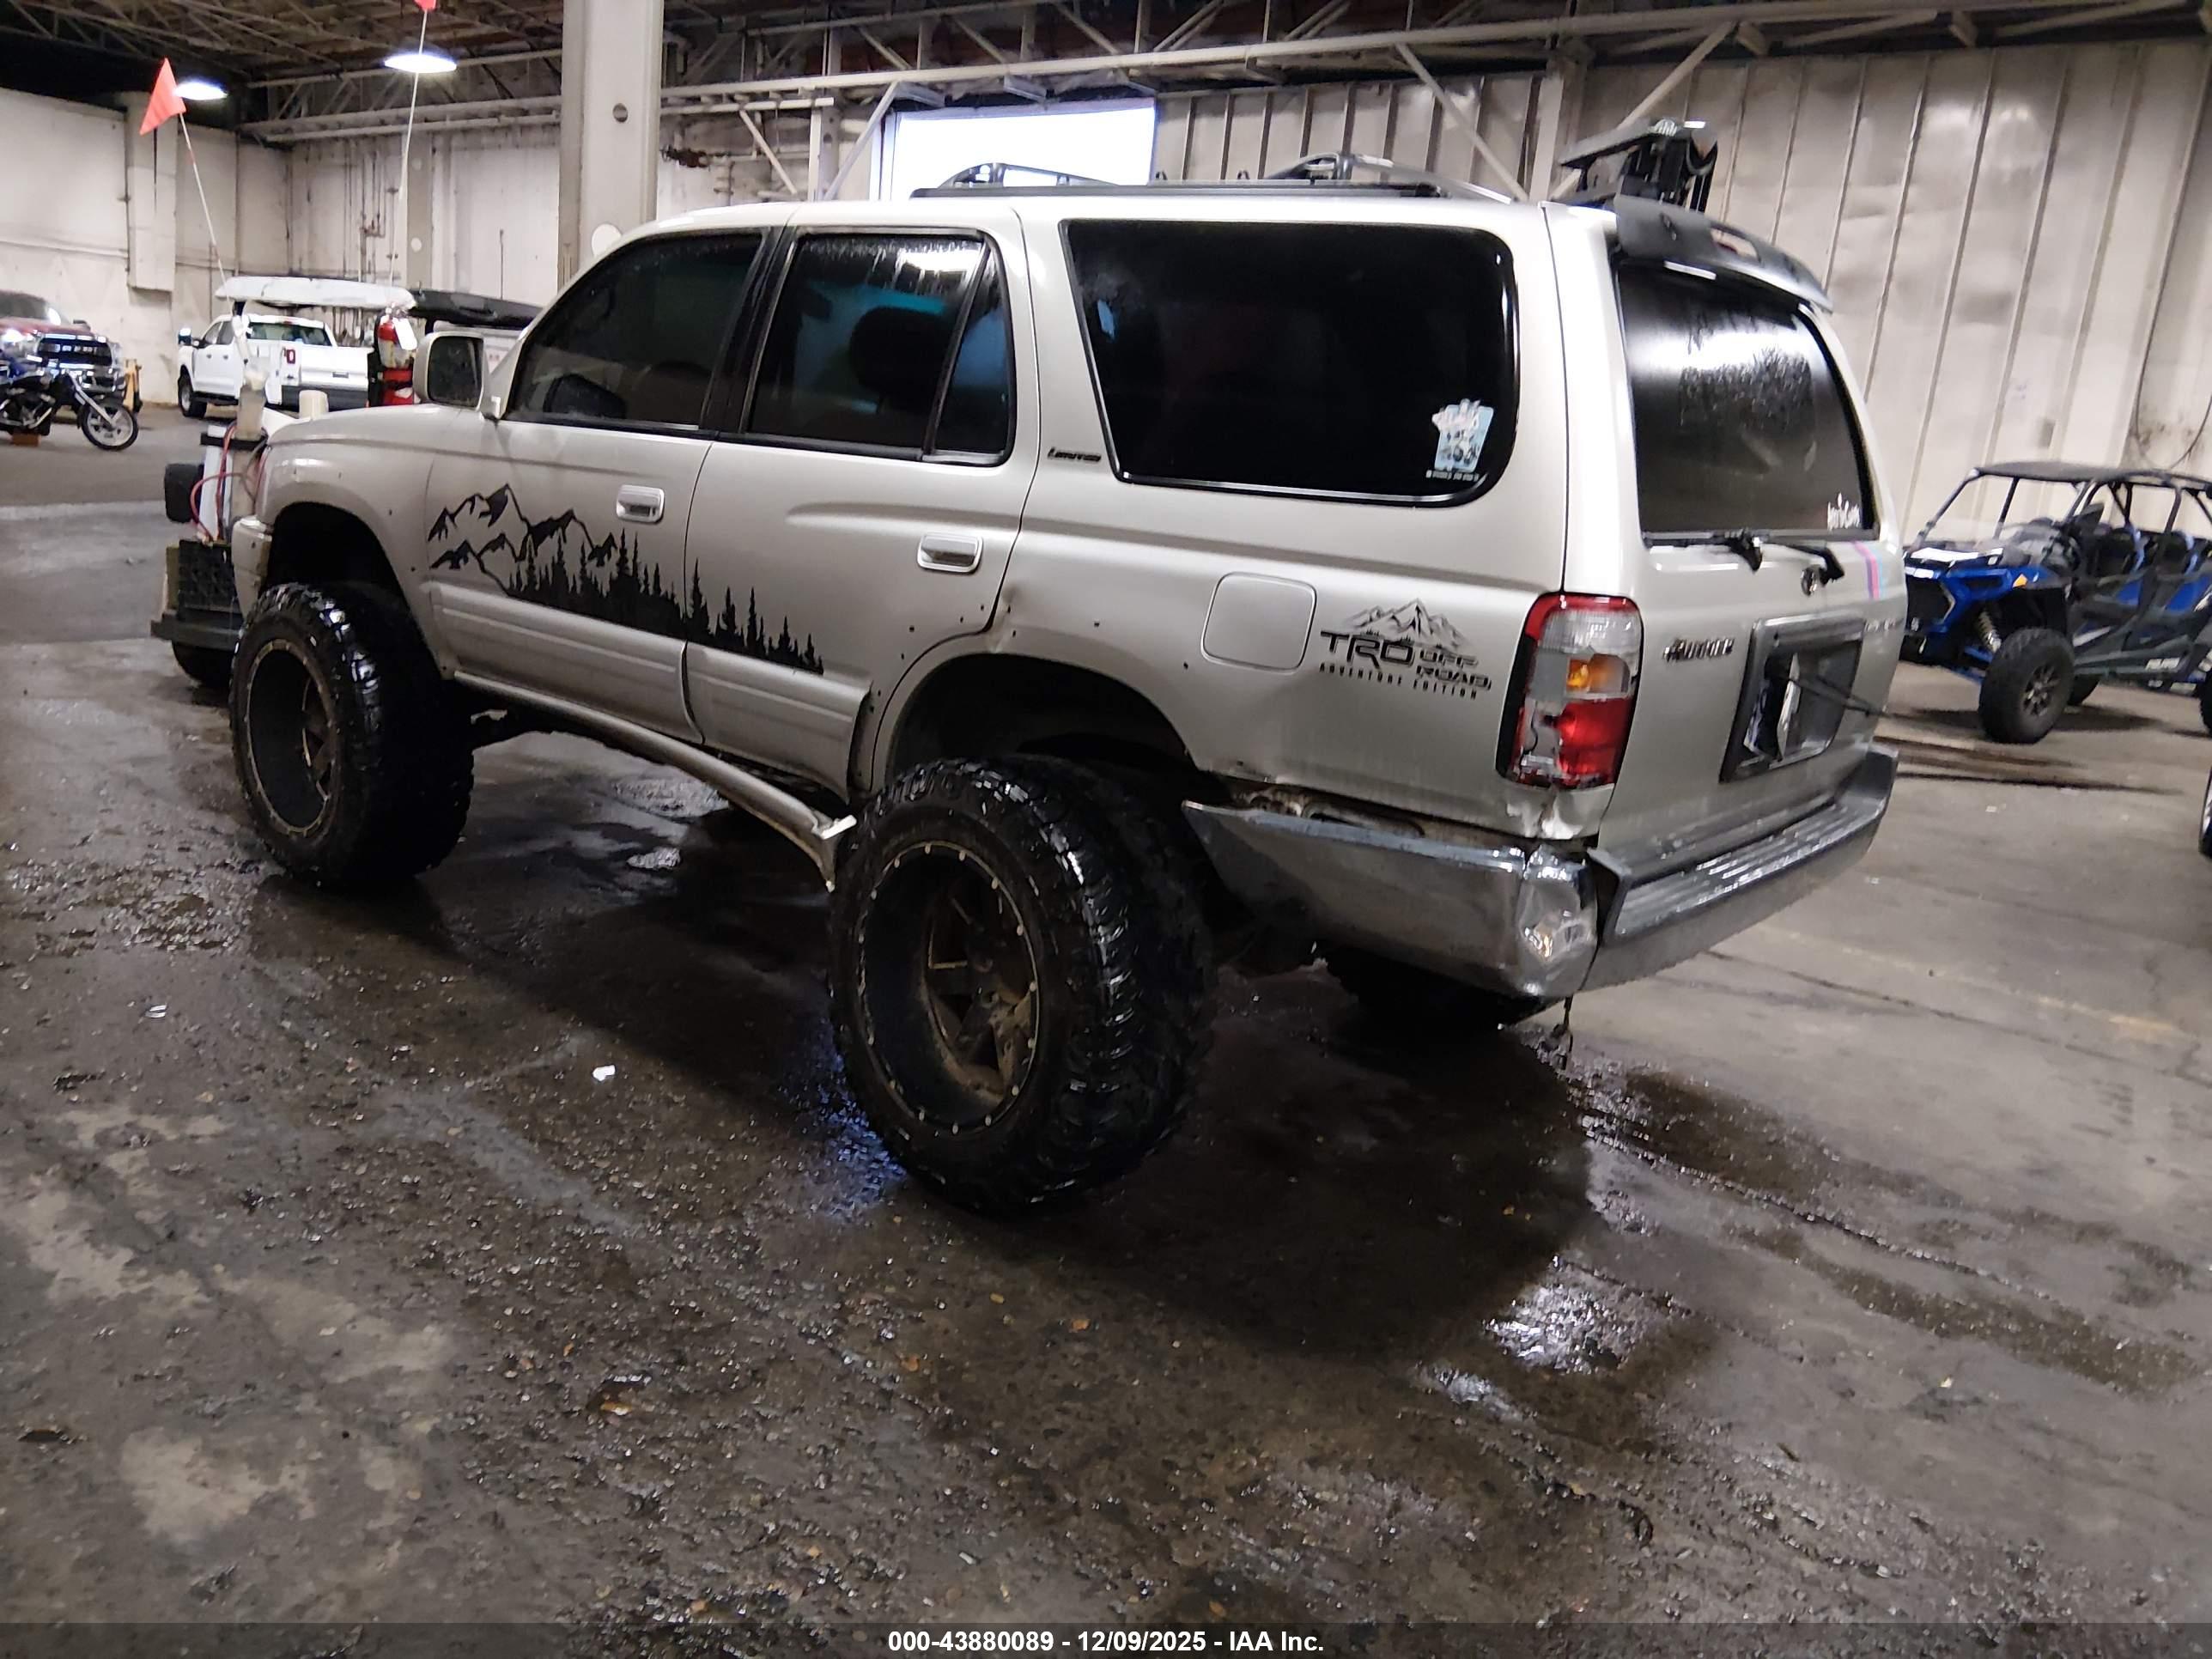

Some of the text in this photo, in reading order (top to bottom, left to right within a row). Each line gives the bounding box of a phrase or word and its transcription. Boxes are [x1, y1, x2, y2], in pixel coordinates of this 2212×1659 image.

[1419, 648, 1479, 668] OFF
[1319, 662, 1478, 700] ADVENTURE EDITION
[1415, 665, 1492, 690] ROAD
